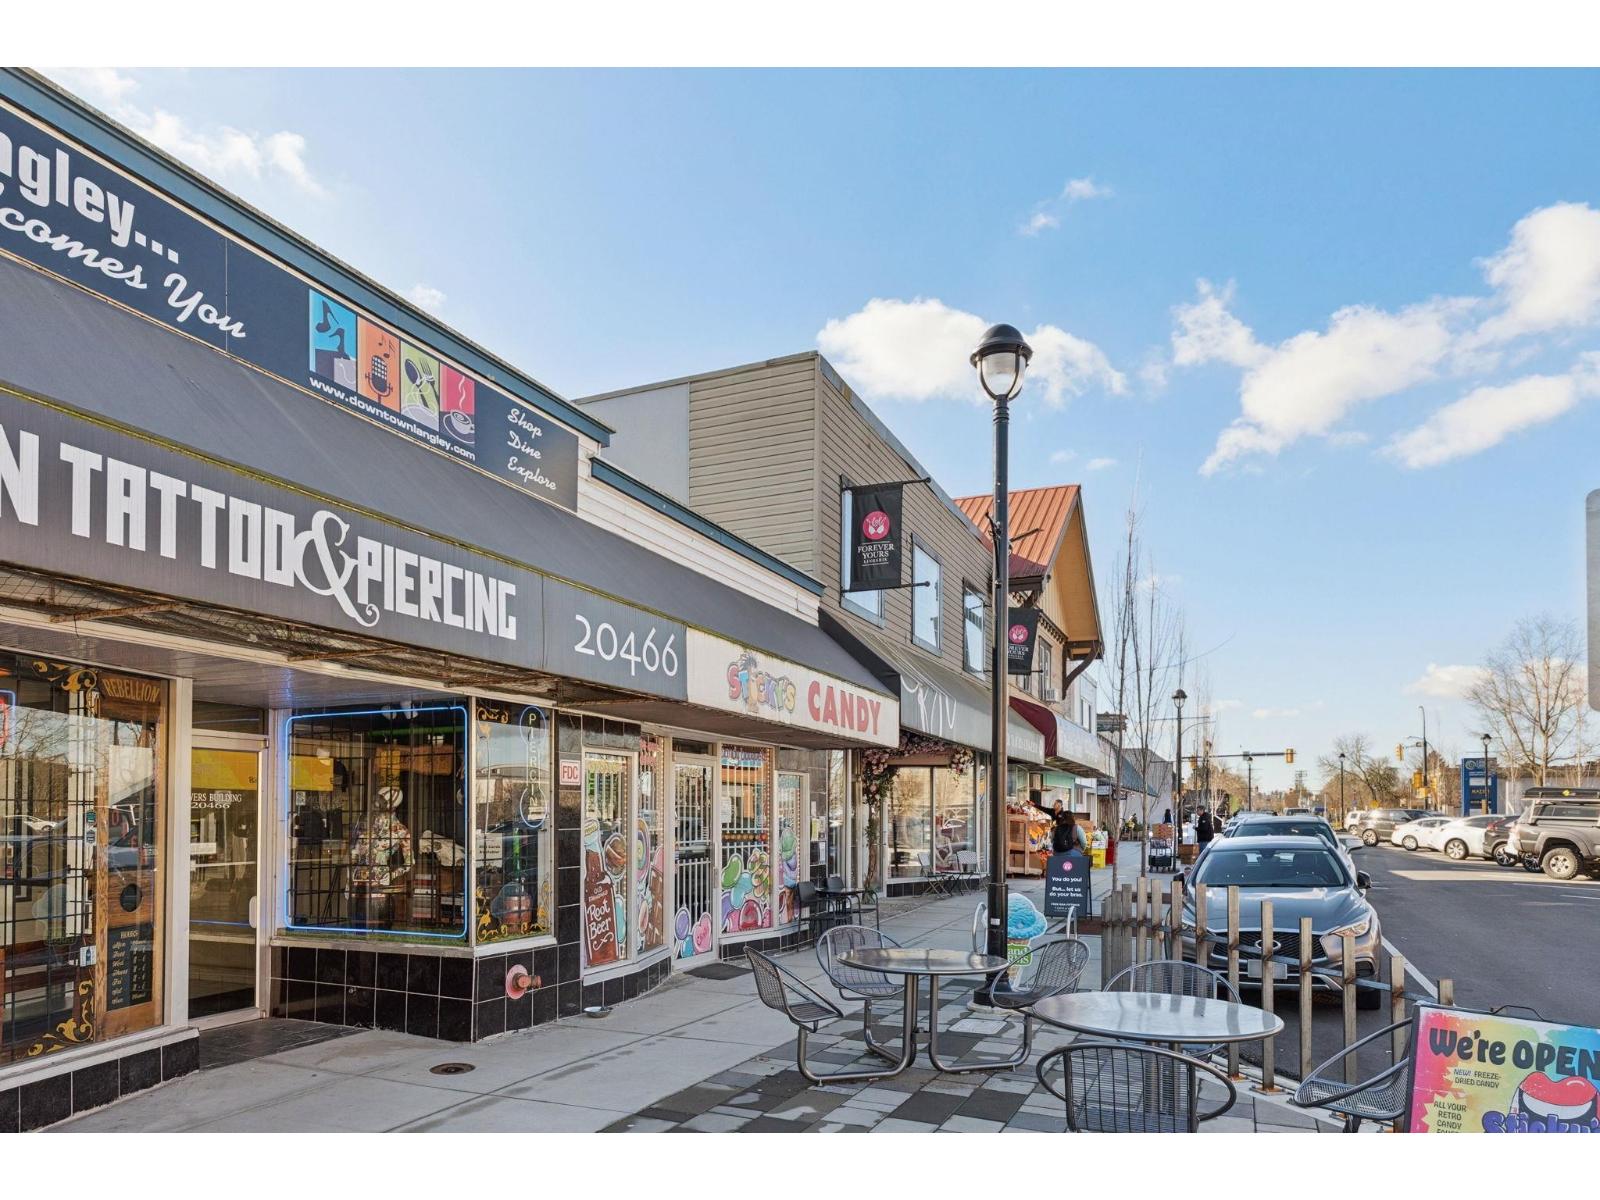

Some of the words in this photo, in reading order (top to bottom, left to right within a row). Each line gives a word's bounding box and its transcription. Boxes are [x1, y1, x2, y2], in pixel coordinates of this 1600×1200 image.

[0, 182, 147, 289] comes
[164, 273, 246, 338] You
[309, 376, 476, 461] www.downtownlangley.com
[507, 408, 543, 438] Shop
[507, 431, 542, 460] Dine
[507, 456, 557, 491] Explore
[0, 423, 39, 526] N
[60, 442, 295, 587] TATTOO
[294, 510, 380, 627] &
[357, 536, 517, 640] PIERCING
[857, 543, 895, 554] FOREVER
[862, 550, 889, 559] YOURS
[574, 614, 678, 677] 20466
[102, 678, 160, 703] REBELLION
[807, 680, 881, 735] CANDY
[562, 765, 579, 780] FDC
[191, 801, 231, 809] 20466
[209, 793, 242, 803] BUILDING
[587, 897, 611, 922] Root
[589, 915, 612, 940] Beer
[1007, 947, 1028, 956] and
[1429, 1028, 1507, 1066] We're
[1512, 1039, 1600, 1080] OPEN
[1453, 1068, 1472, 1077] NEW!
[1474, 1070, 1502, 1081] FREEZE-
[1454, 1078, 1476, 1086] DRIED
[1476, 1078, 1500, 1089] CANDY
[1434, 1100, 1448, 1110] ALL
[1447, 1102, 1467, 1113] YOUR
[1438, 1110, 1462, 1121] RETRO
[1437, 1119, 1463, 1131] CANDY
